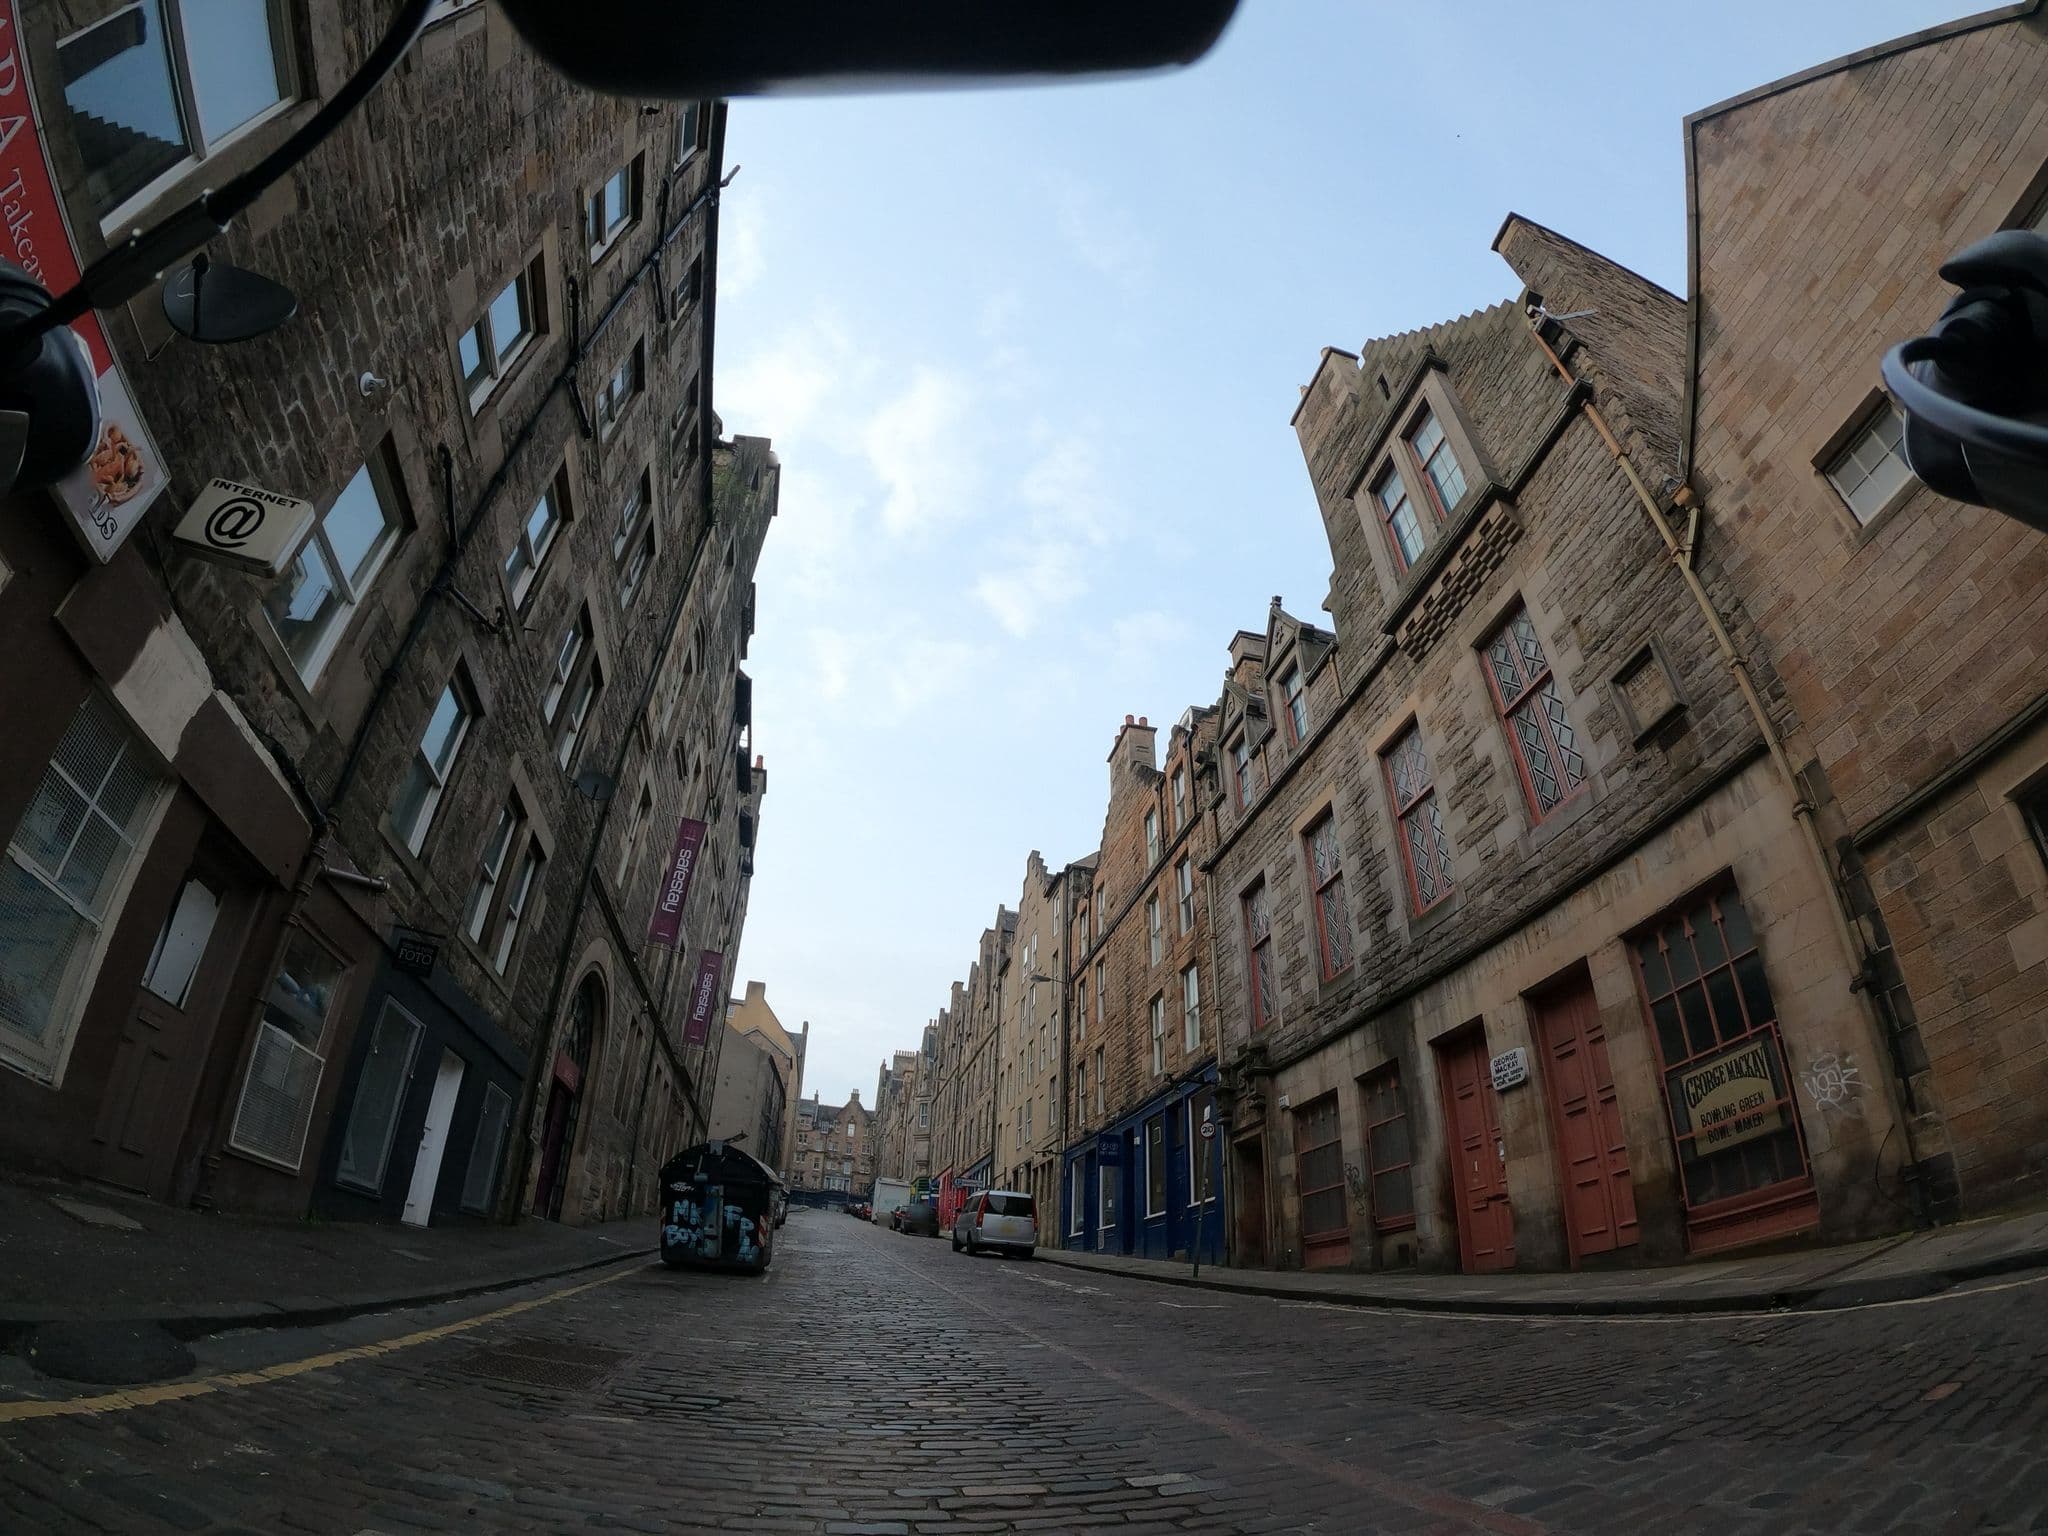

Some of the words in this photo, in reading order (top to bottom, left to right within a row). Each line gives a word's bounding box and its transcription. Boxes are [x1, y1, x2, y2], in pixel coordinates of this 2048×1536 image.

[212, 479, 302, 509] INTERNET
[204, 496, 266, 548] @
[661, 848, 693, 913] safestay
[399, 947, 433, 965] FOTO
[692, 972, 714, 1022] safestay
[1493, 1051, 1518, 1067] GEORGE
[1494, 1059, 1519, 1074] MACKAY
[1510, 1067, 1524, 1075] GREEN
[1685, 1066, 1725, 1109] GEORGE
[1727, 1047, 1769, 1083] MACKAY
[1700, 1102, 1737, 1129] BOWLING
[1738, 1090, 1765, 1113] GREEN
[1201, 1126, 1214, 1135] 20
[1706, 1125, 1732, 1144] BOWL
[1734, 1111, 1765, 1134] MAKER
